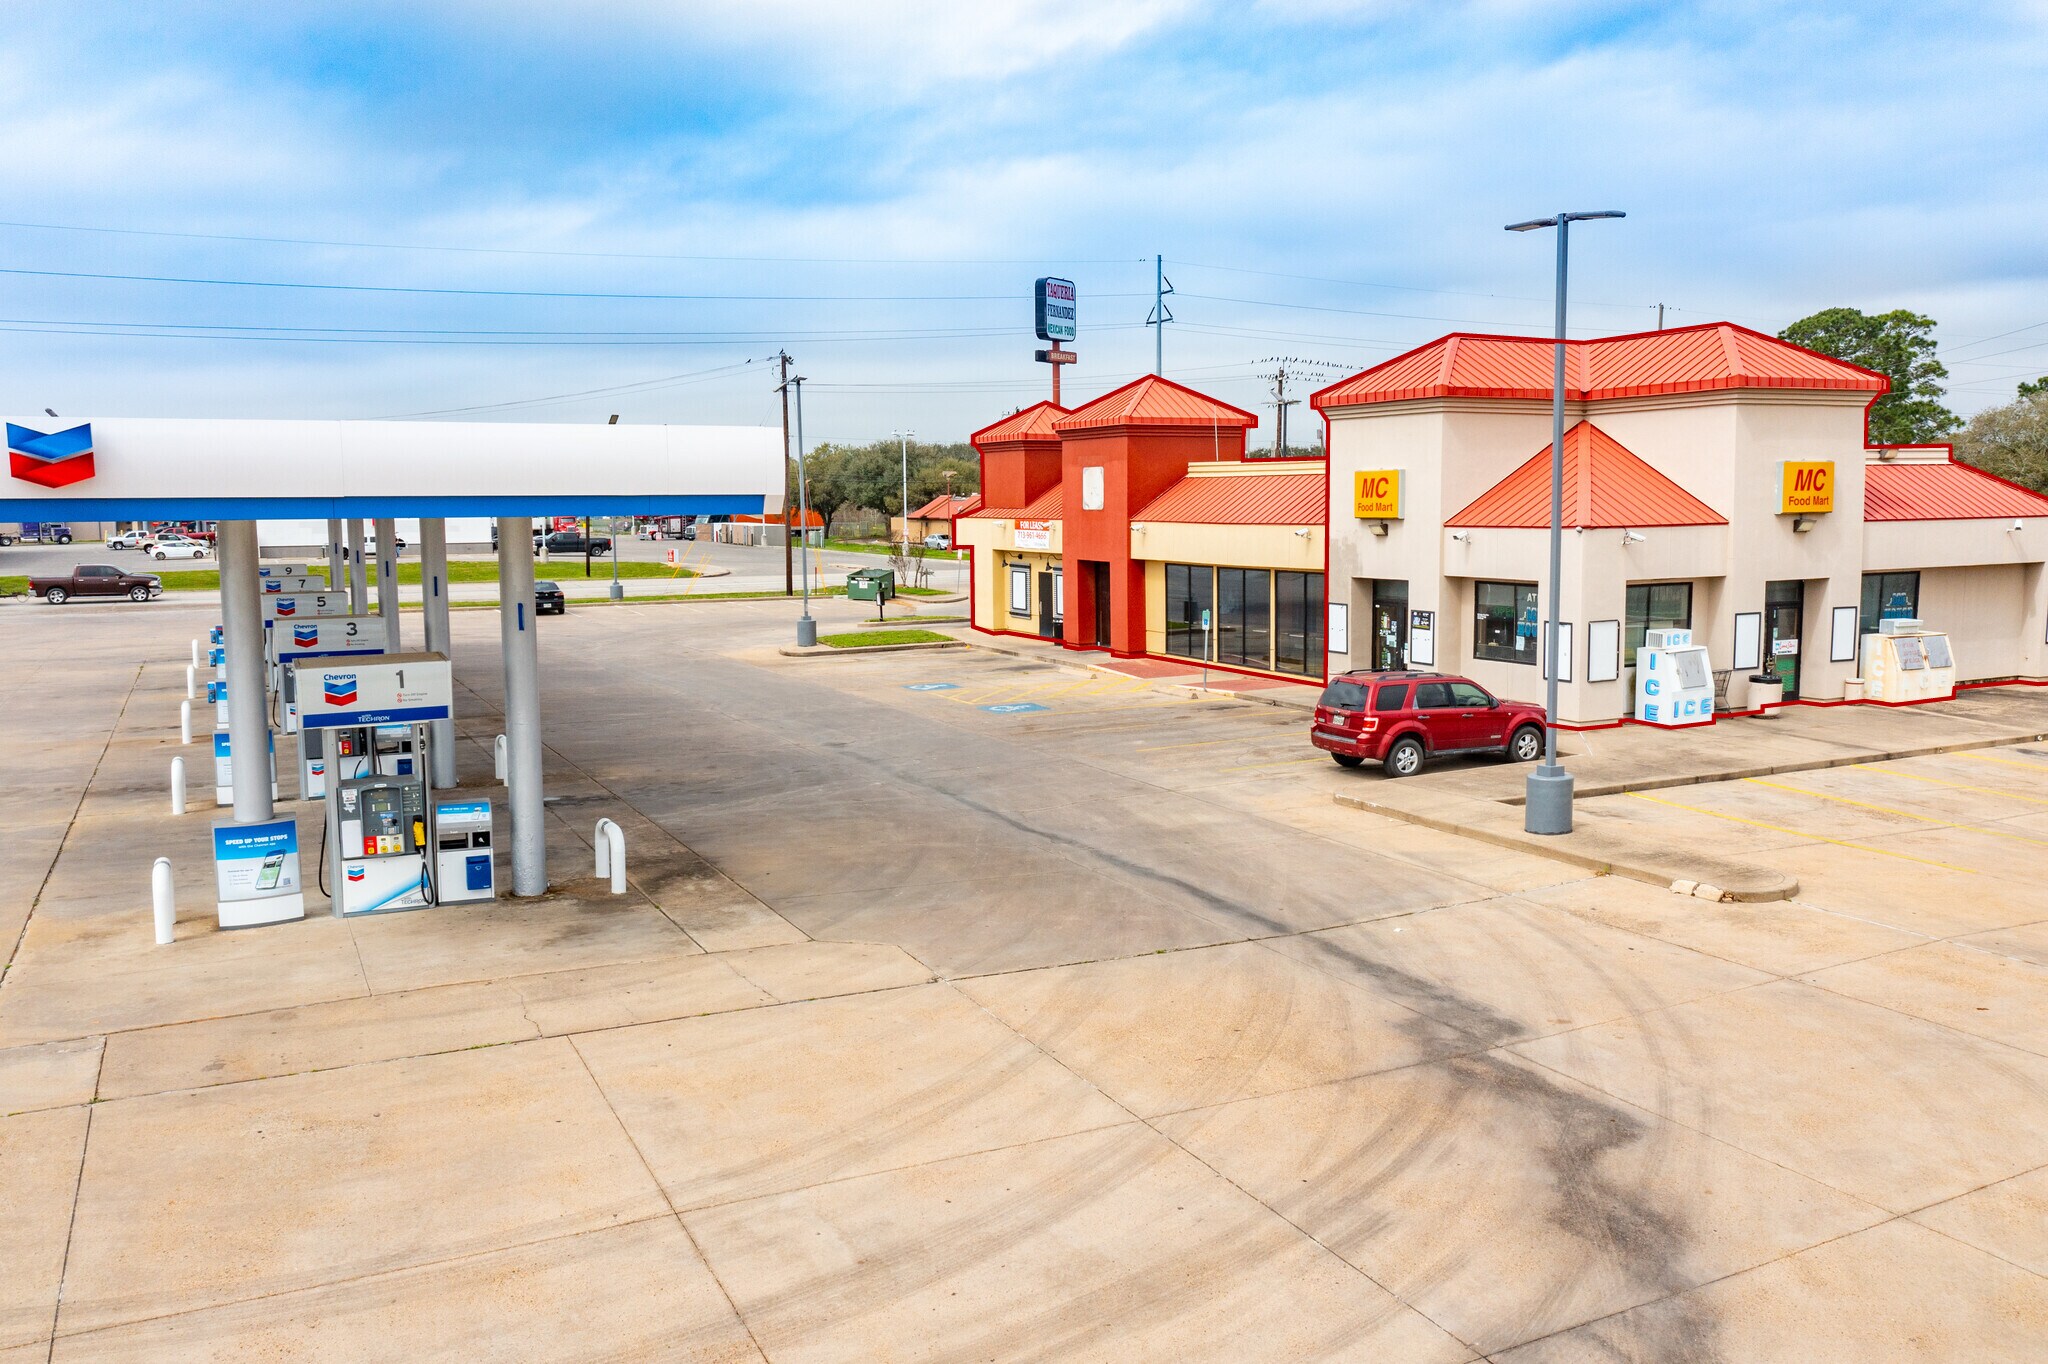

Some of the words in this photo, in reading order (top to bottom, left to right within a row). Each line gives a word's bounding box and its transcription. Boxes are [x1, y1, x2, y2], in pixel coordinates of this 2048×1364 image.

[1046, 282, 1075, 301] TAQUERIA
[1047, 303, 1075, 320] FERNANDEZ
[1047, 323, 1063, 335] MEXICAN
[1064, 324, 1075, 337] FOOD
[1051, 352, 1075, 361] BREAKFAST
[1794, 468, 1827, 492] MC
[1361, 477, 1389, 499] MC
[1357, 502, 1374, 512] Food
[1375, 502, 1393, 512] Mart
[1788, 495, 1811, 506] Food
[1812, 495, 1830, 506] Mart
[1020, 521, 1030, 529] FOR
[1030, 521, 1044, 530] LEAS
[285, 566, 293, 575] 9
[298, 579, 306, 588] 7
[317, 596, 327, 607] 5
[1526, 592, 1539, 603] AT
[346, 622, 358, 636] 3
[1666, 632, 1690, 646] ICE
[323, 673, 357, 681] Chevron
[395, 669, 405, 689] 1
[1645, 652, 1660, 722] ICE
[1673, 696, 1713, 719] ICE
[357, 715, 391, 723] TECHRON
[225, 838, 244, 846] SPEED
[269, 833, 288, 842] STOPS
